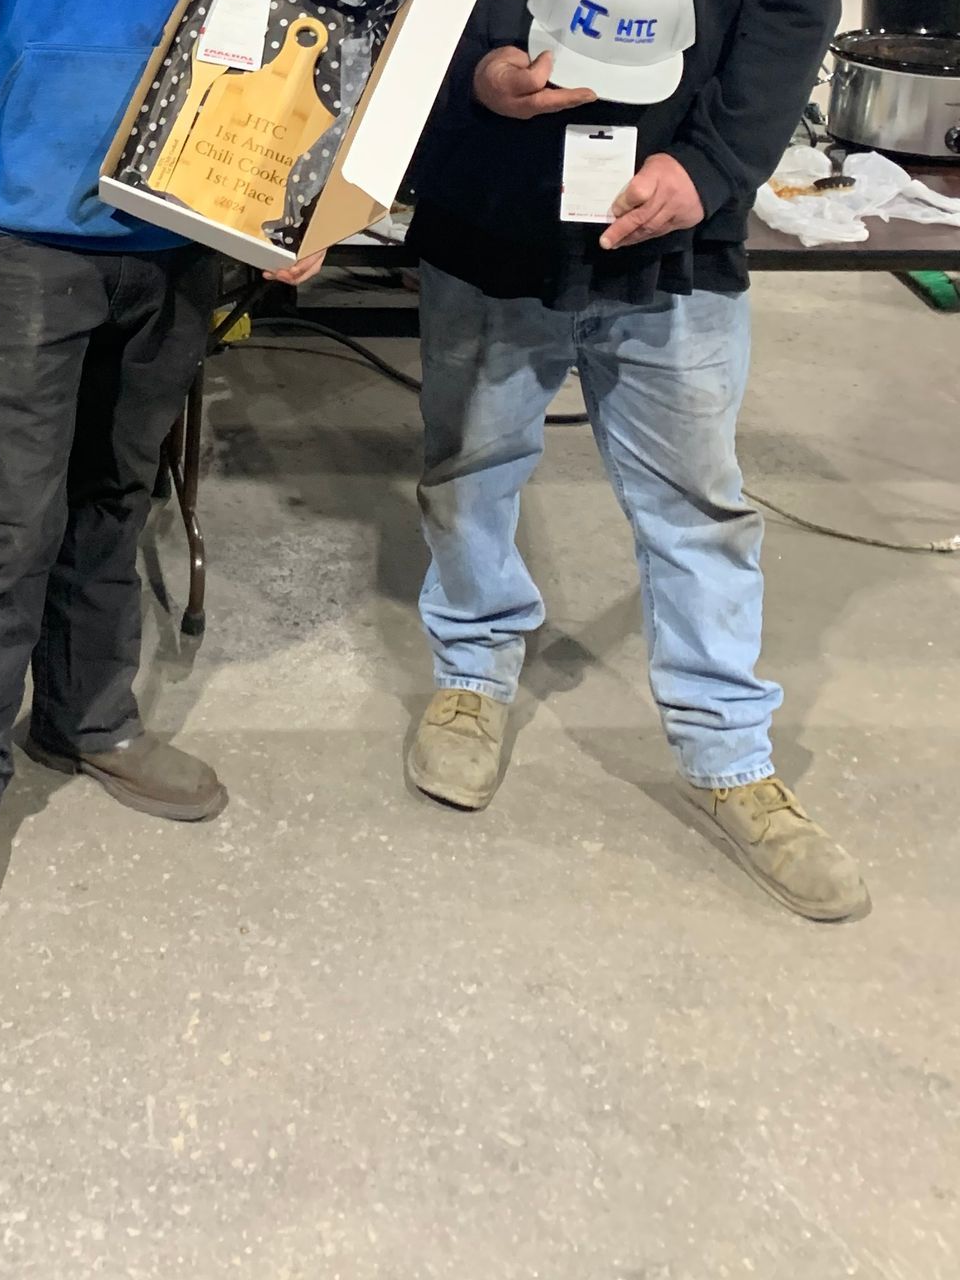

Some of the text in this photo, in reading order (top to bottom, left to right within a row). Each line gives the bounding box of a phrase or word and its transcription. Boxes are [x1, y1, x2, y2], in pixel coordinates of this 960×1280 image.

[616, 18, 658, 37] HTC
[242, 112, 287, 140] HTC
[194, 139, 235, 166] Chili
[215, 124, 294, 167] 1st Annua
[205, 166, 275, 207] 1st Place
